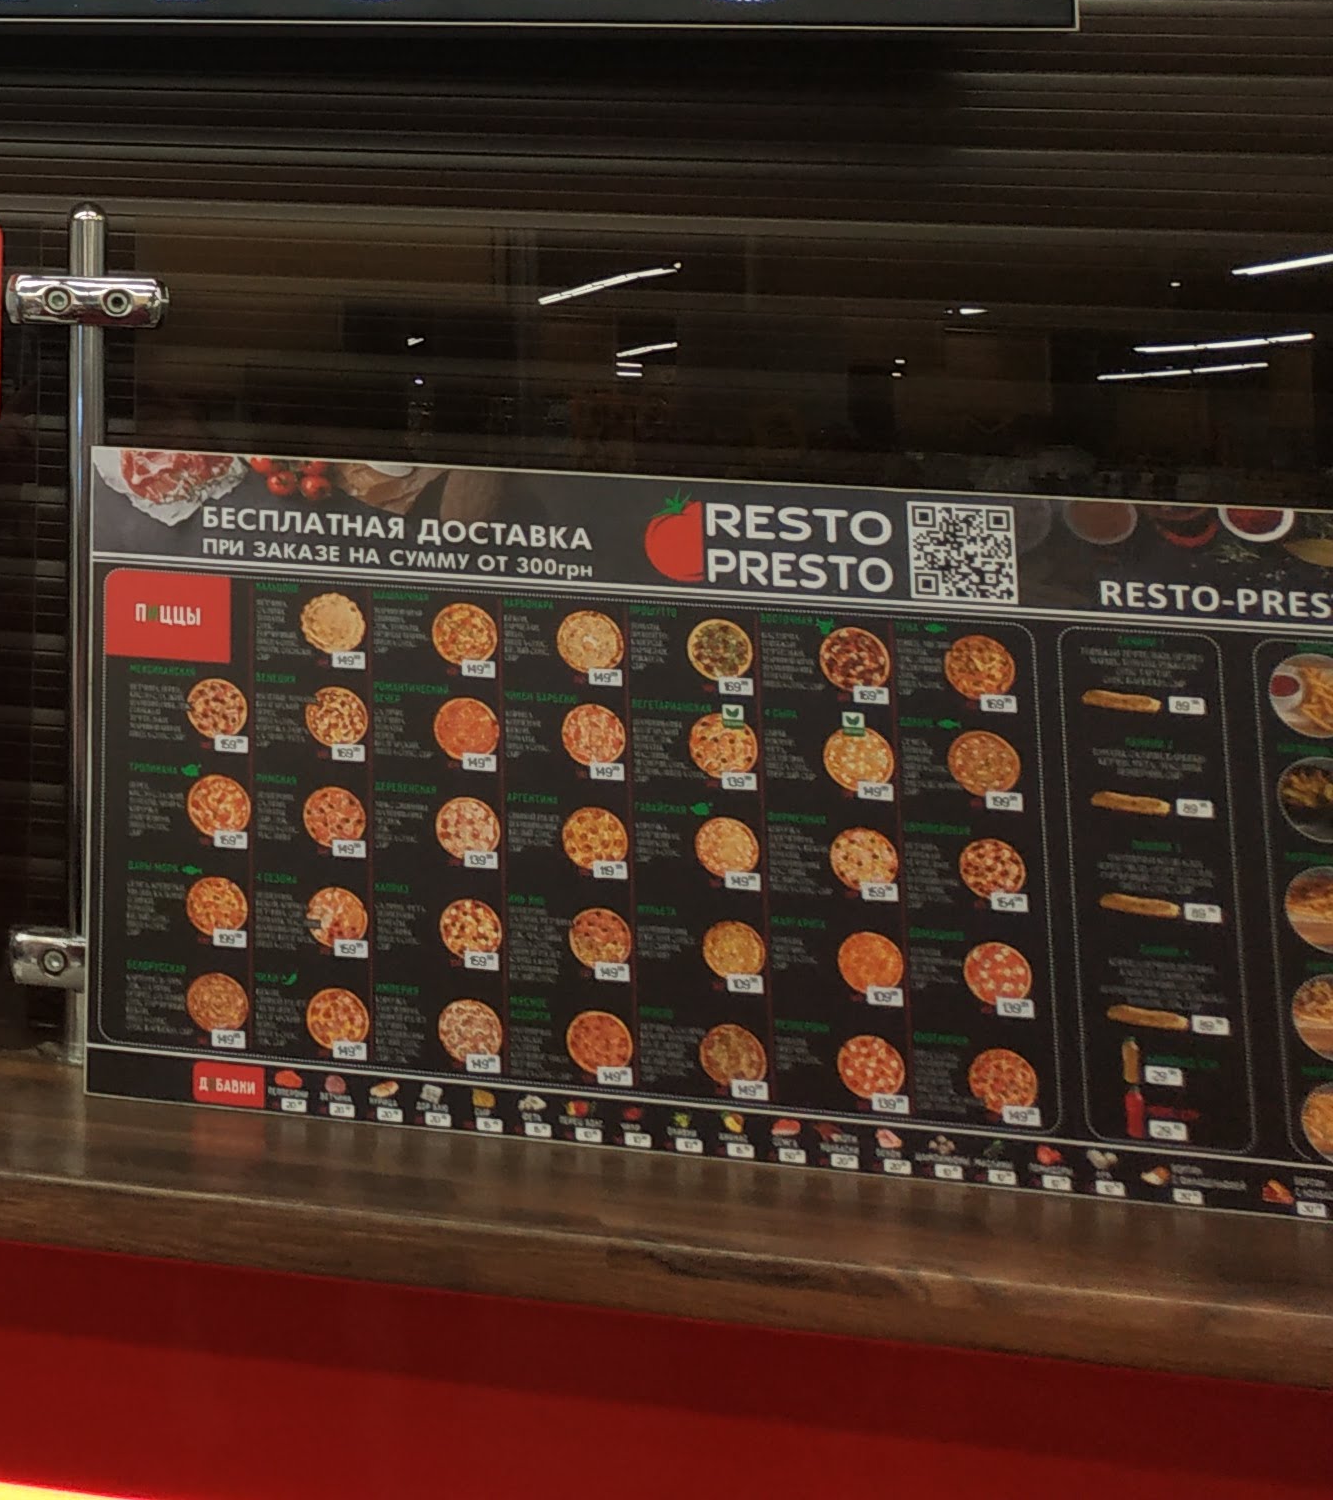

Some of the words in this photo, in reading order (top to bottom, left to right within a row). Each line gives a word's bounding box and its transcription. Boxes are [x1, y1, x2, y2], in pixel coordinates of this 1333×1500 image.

[203, 506, 405, 540] БЕСПЛАТНАЯ
[418, 519, 593, 551] ДОСТАВКА
[706, 502, 893, 546] RESTO
[203, 538, 245, 557] ПРИ
[254, 541, 340, 563] ЗАКАЗЕ
[348, 547, 381, 566] НА
[390, 548, 469, 571] СУММУ
[478, 554, 508, 572] ОТ
[516, 555, 594, 582] 300грн
[706, 546, 893, 594] PRESTO
[1100, 580, 1333, 619] RESTO-PRES
